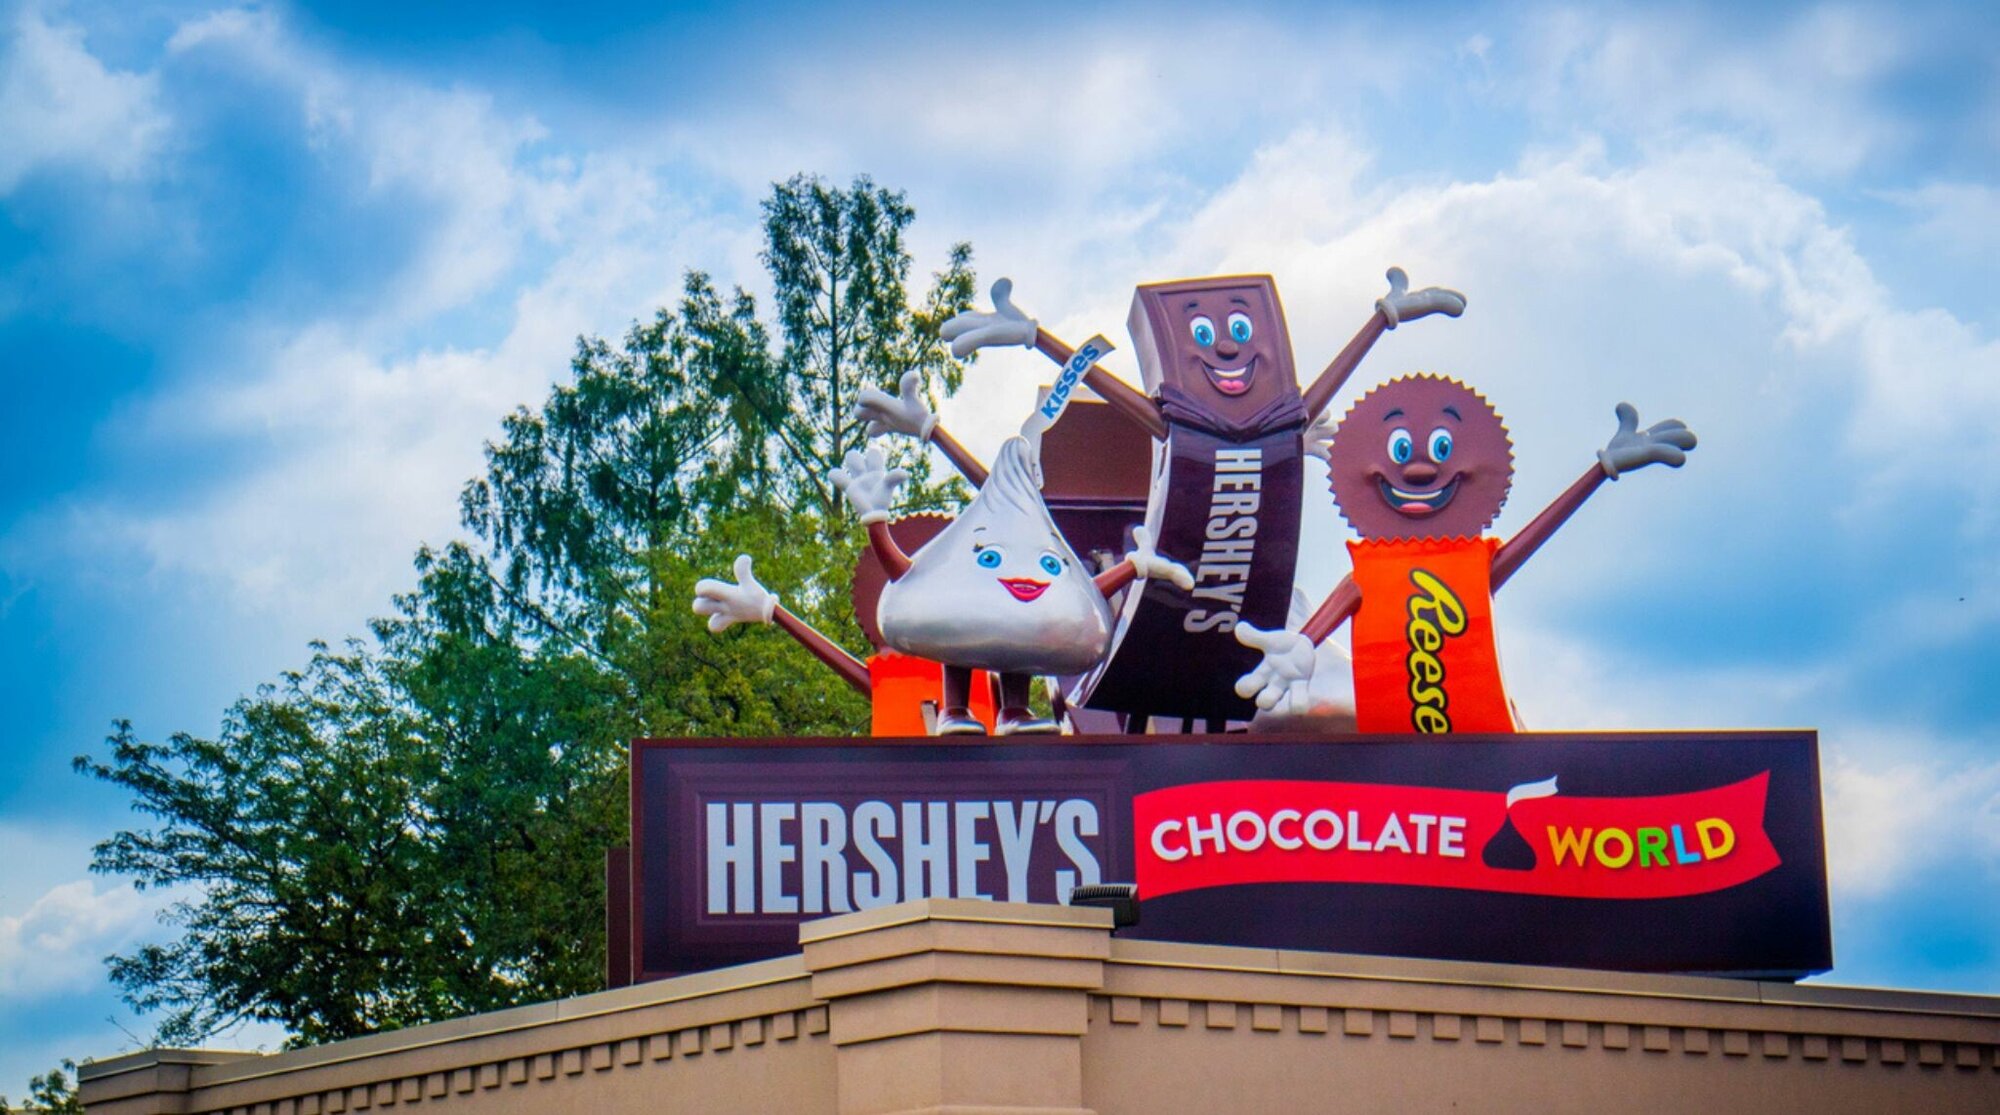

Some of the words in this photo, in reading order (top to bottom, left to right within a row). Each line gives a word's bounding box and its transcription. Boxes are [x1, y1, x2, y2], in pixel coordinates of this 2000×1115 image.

[1183, 449, 1262, 633] HERSHEY'S
[706, 800, 1101, 914] HERSHEY'S
[1150, 809, 1467, 861] CHOCOLATE
[1546, 817, 1736, 869] WORLD
